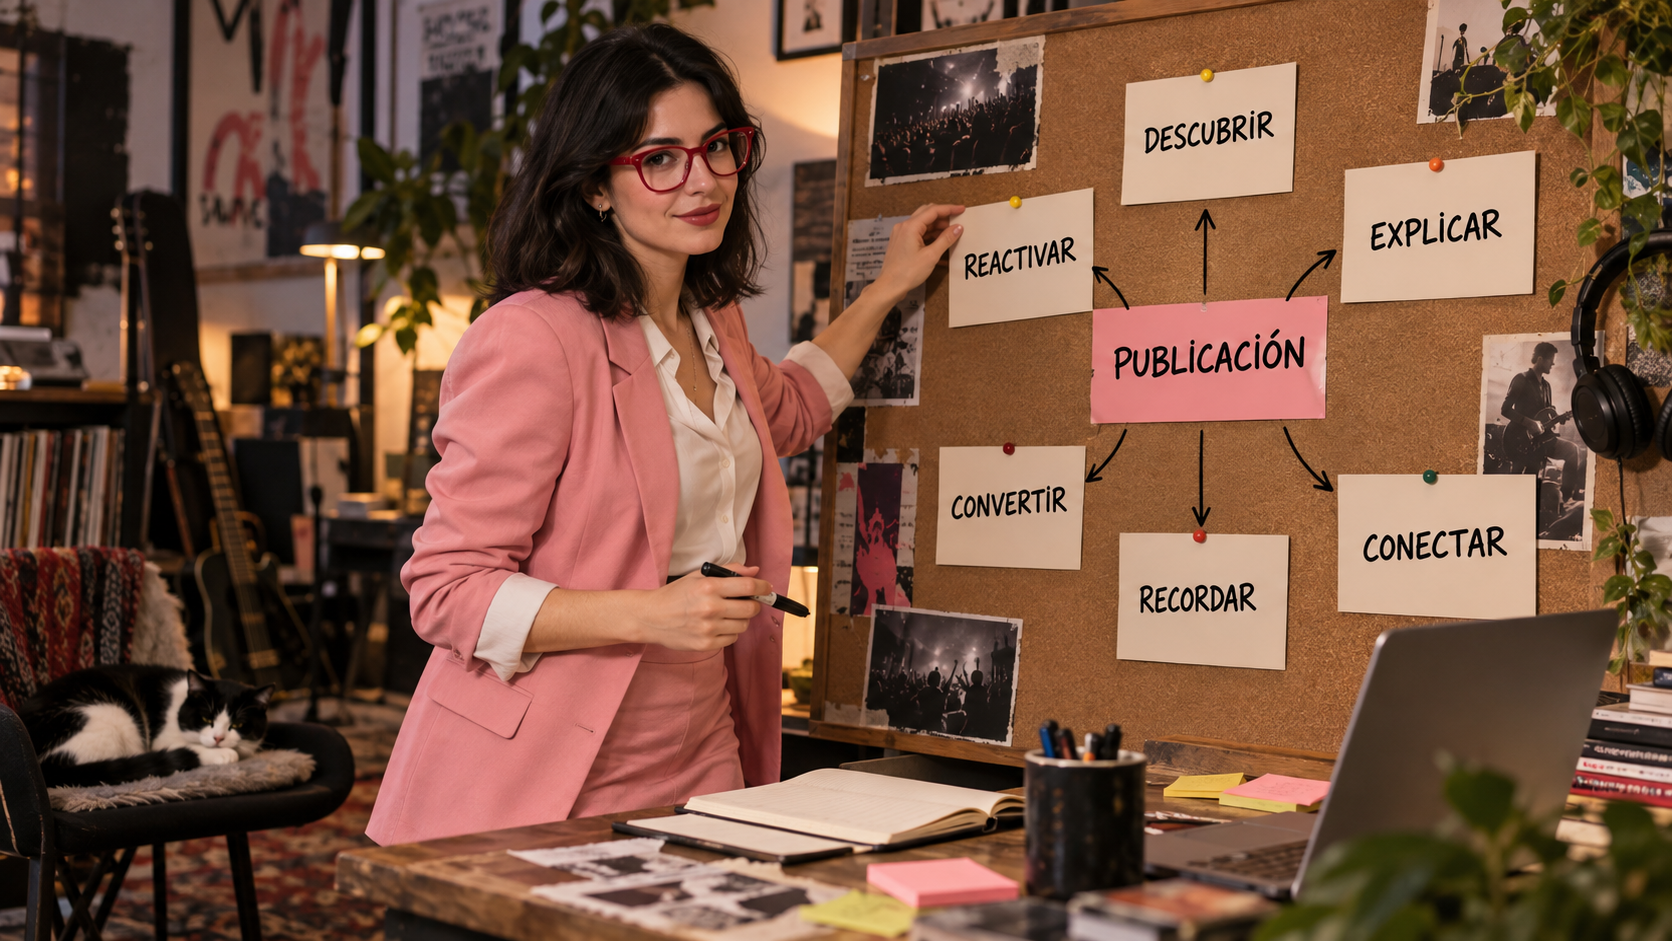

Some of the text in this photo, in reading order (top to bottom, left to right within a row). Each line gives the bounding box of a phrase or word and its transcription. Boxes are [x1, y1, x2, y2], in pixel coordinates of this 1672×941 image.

[965, 237, 1077, 281] REACTIVAR
[1363, 526, 1508, 563] CONECTAR
[1140, 583, 1257, 614] RECORDAR
